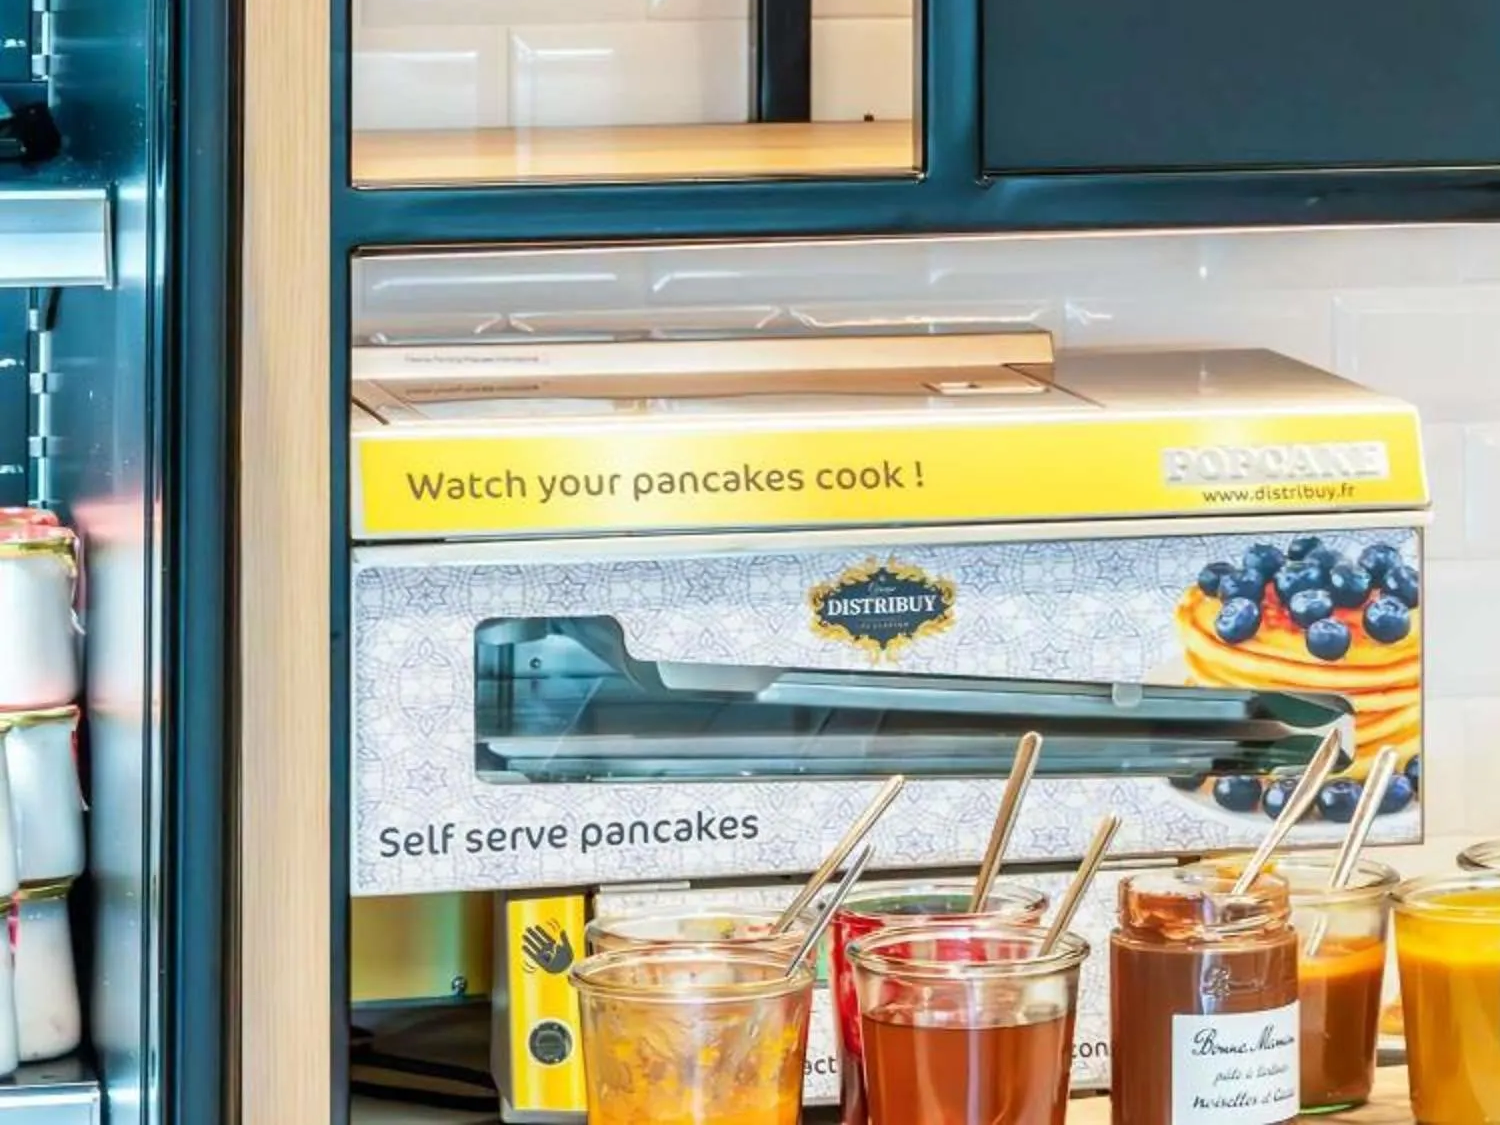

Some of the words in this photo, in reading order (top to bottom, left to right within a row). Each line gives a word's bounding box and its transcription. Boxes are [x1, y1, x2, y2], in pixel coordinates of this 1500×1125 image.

[406, 469, 527, 501] Watch
[537, 473, 621, 504] your
[633, 463, 805, 502] pancakes
[815, 460, 905, 491] cook
[1202, 482, 1356, 503] www.distribuy.fr
[827, 594, 938, 617] DISTRIBUY
[379, 822, 455, 858] Self
[465, 824, 568, 854] serve
[581, 810, 759, 854] pancakes
[1191, 1027, 1249, 1056] Bonne
